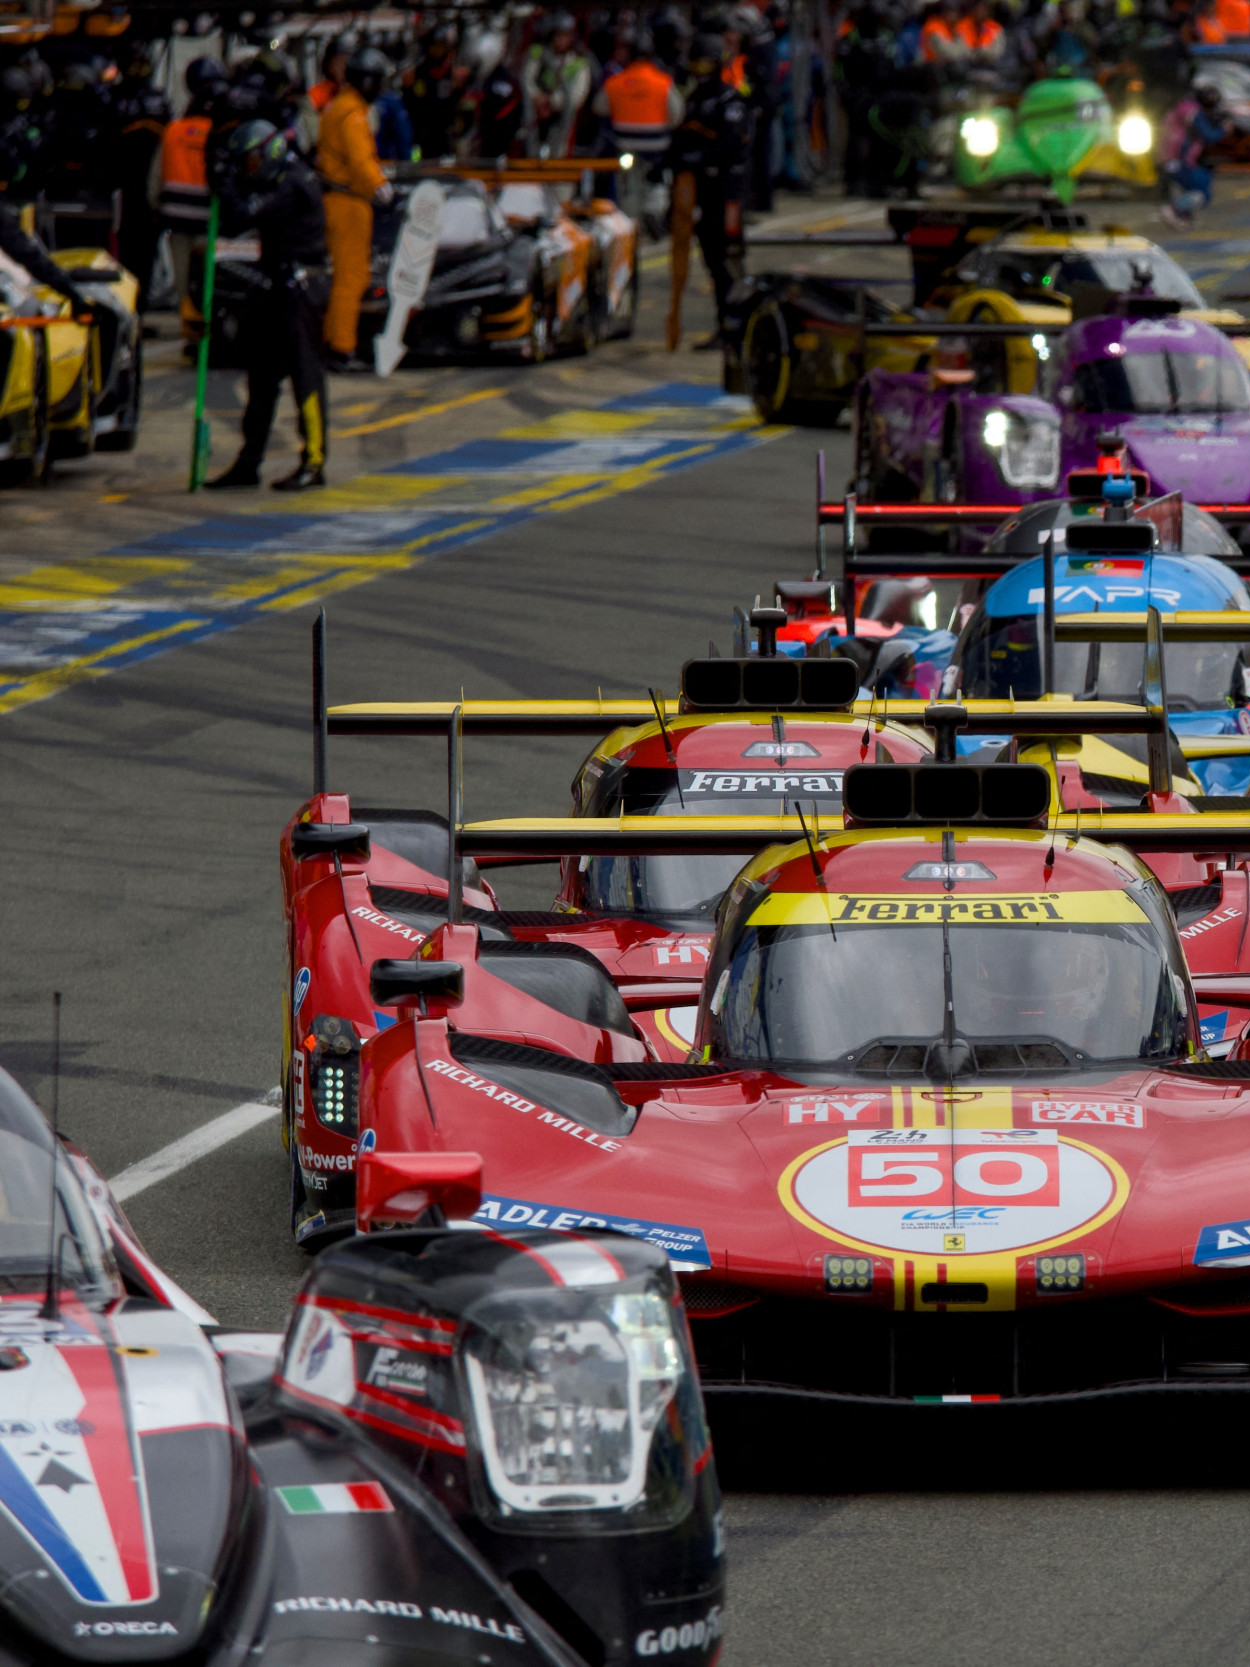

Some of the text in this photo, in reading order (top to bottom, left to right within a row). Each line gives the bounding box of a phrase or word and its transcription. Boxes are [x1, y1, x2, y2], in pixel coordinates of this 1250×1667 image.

[831, 895, 1065, 921] Ferrari
[1178, 907, 1243, 940] MILLE
[424, 1058, 624, 1153] RICHARD MILLE
[788, 1100, 872, 1124] HY
[1038, 1102, 1136, 1114] HYPER
[1038, 1109, 1136, 1126] CAR
[858, 1150, 1049, 1198] 50
[902, 1207, 1007, 1220] WEC
[648, 1228, 702, 1243] PELZER
[96, 1621, 178, 1636] ORECA
[274, 1596, 527, 1644] RICHARD MILLE
